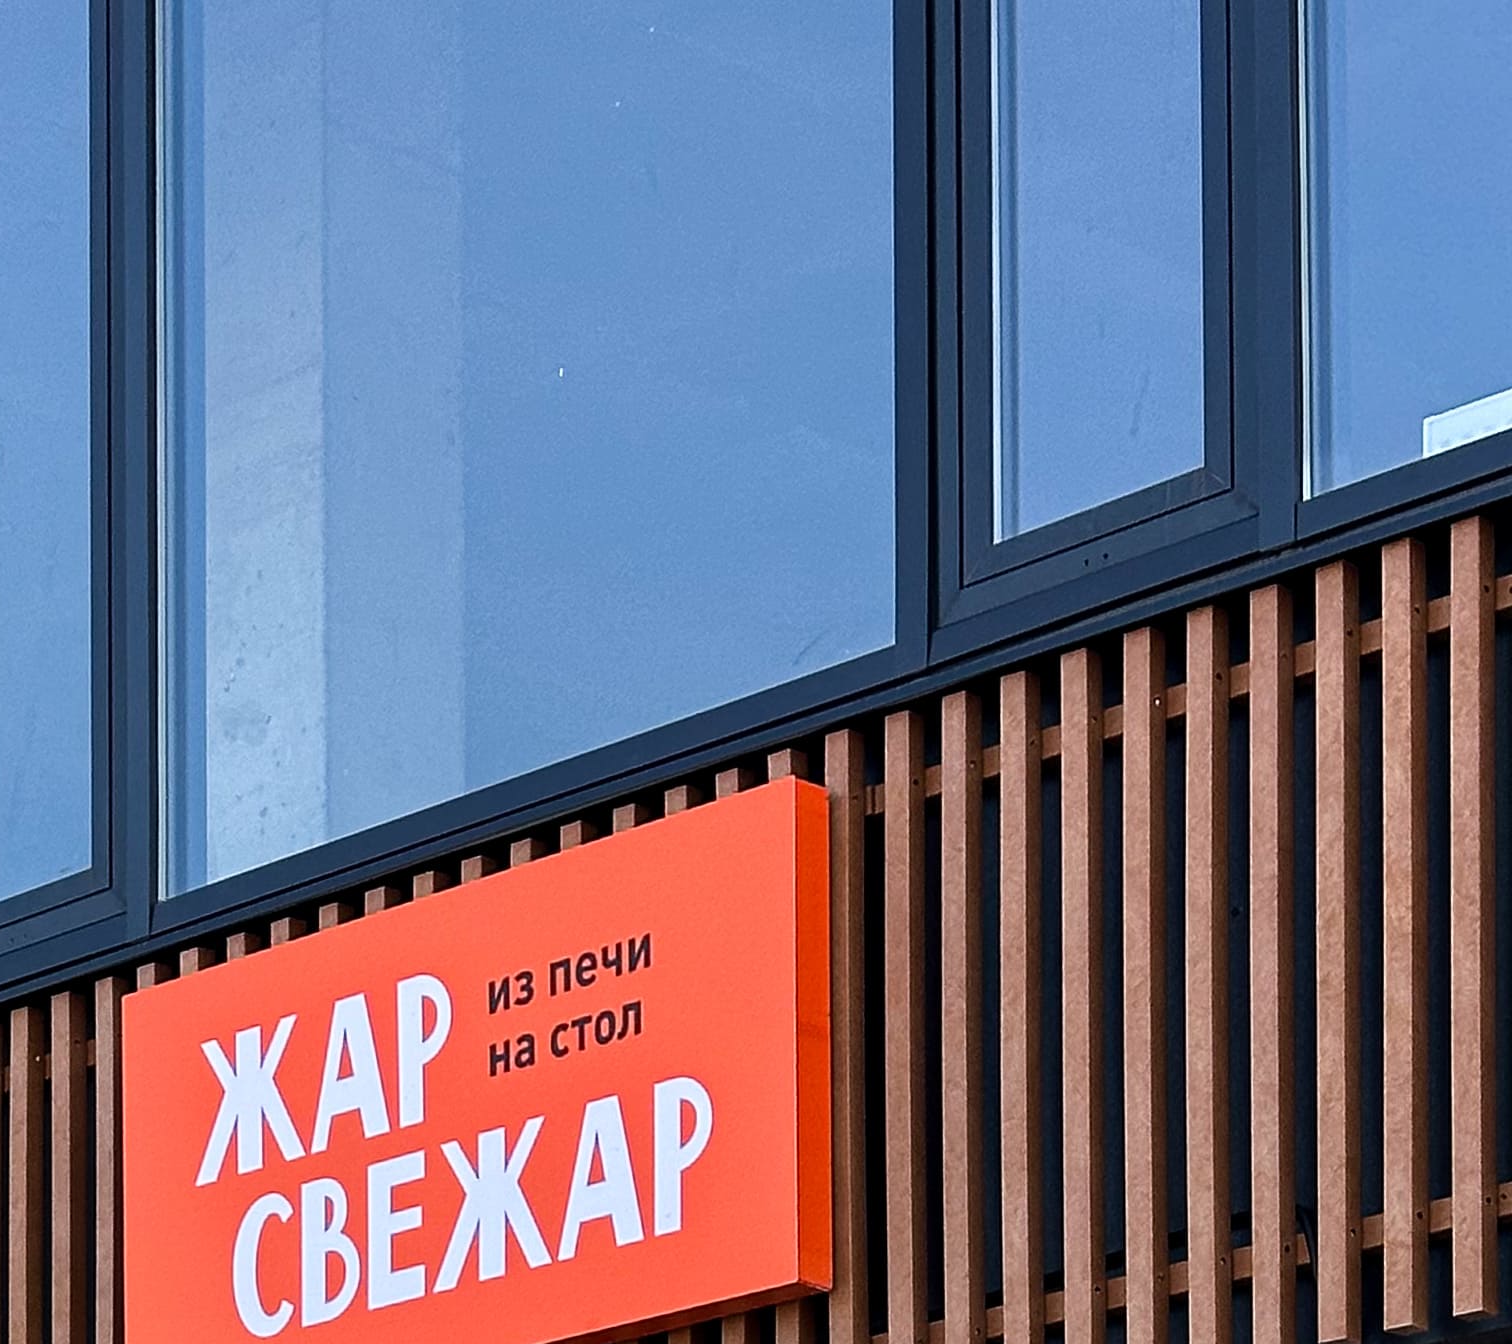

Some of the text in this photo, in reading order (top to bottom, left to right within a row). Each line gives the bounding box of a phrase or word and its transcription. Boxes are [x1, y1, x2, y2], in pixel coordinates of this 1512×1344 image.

[488, 932, 653, 1016] из печи
[489, 999, 643, 1077] на стол
[194, 973, 453, 1188] ЖАР
[231, 1075, 714, 1339] СВЕЖАР
